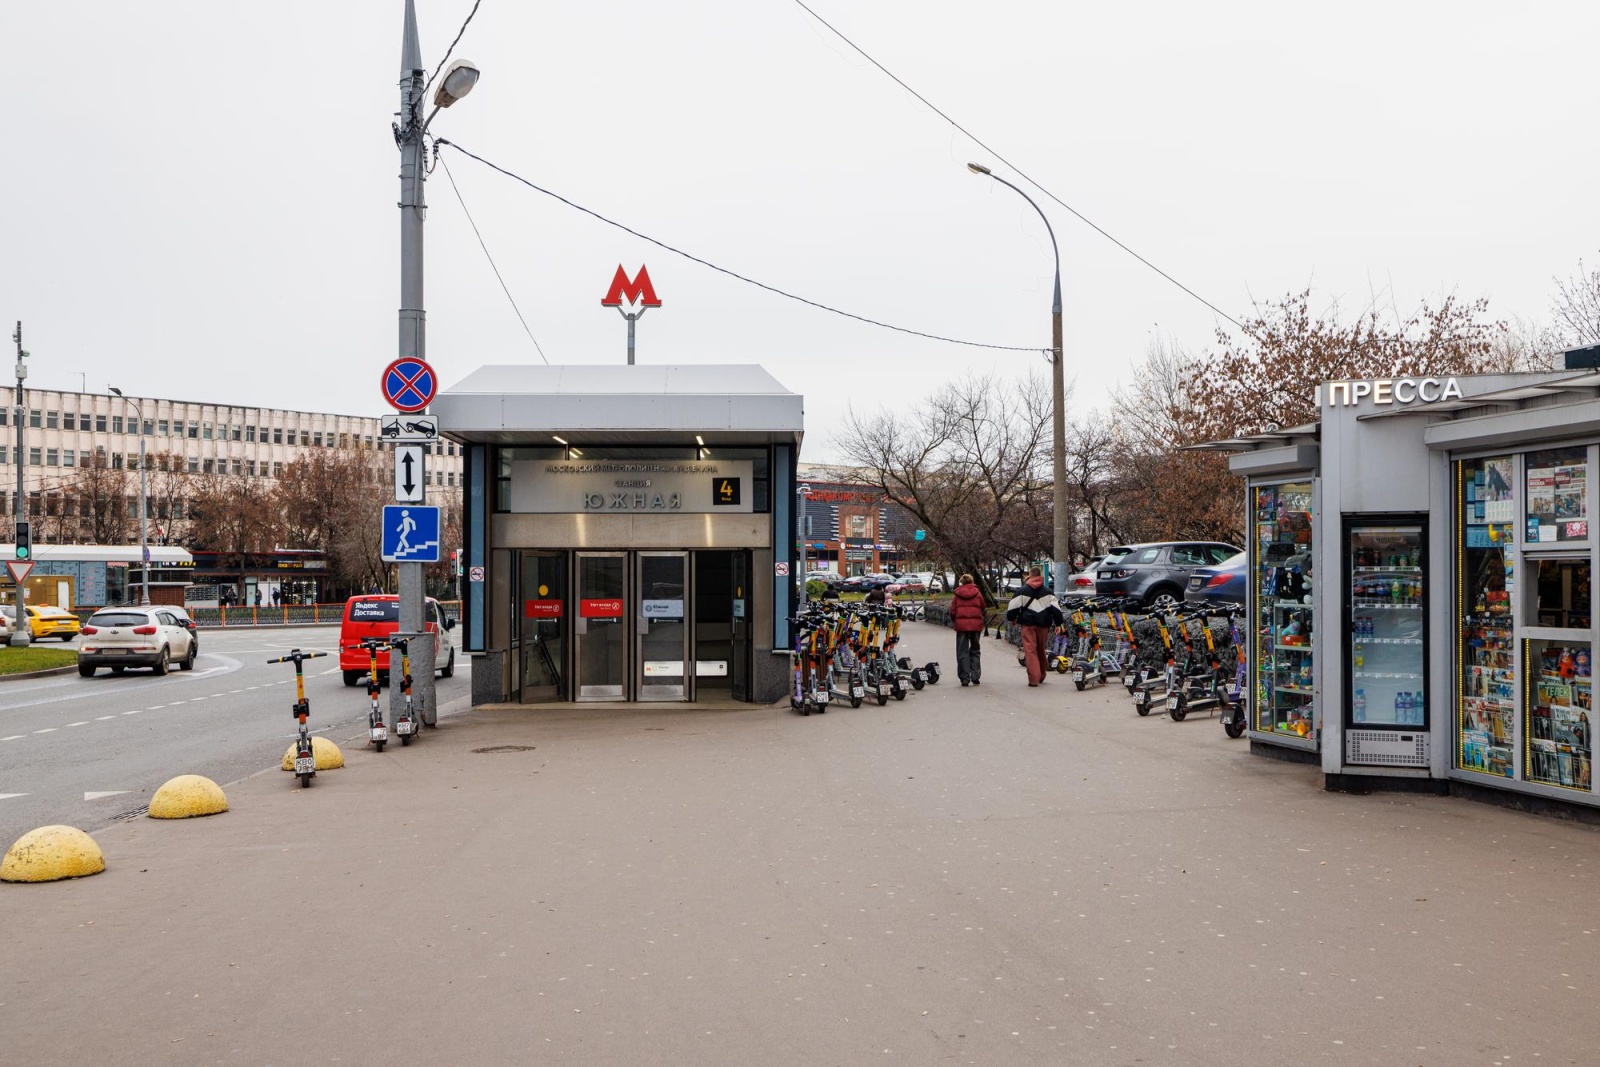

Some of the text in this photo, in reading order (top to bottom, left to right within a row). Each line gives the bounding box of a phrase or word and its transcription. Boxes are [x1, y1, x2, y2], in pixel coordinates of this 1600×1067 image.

[601, 263, 661, 306] М
[1329, 378, 1463, 406] ПРЕССА
[615, 479, 652, 488] СТАНЦИЯ
[720, 480, 733, 496] 4
[584, 492, 682, 509] ЮЖНАЯ
